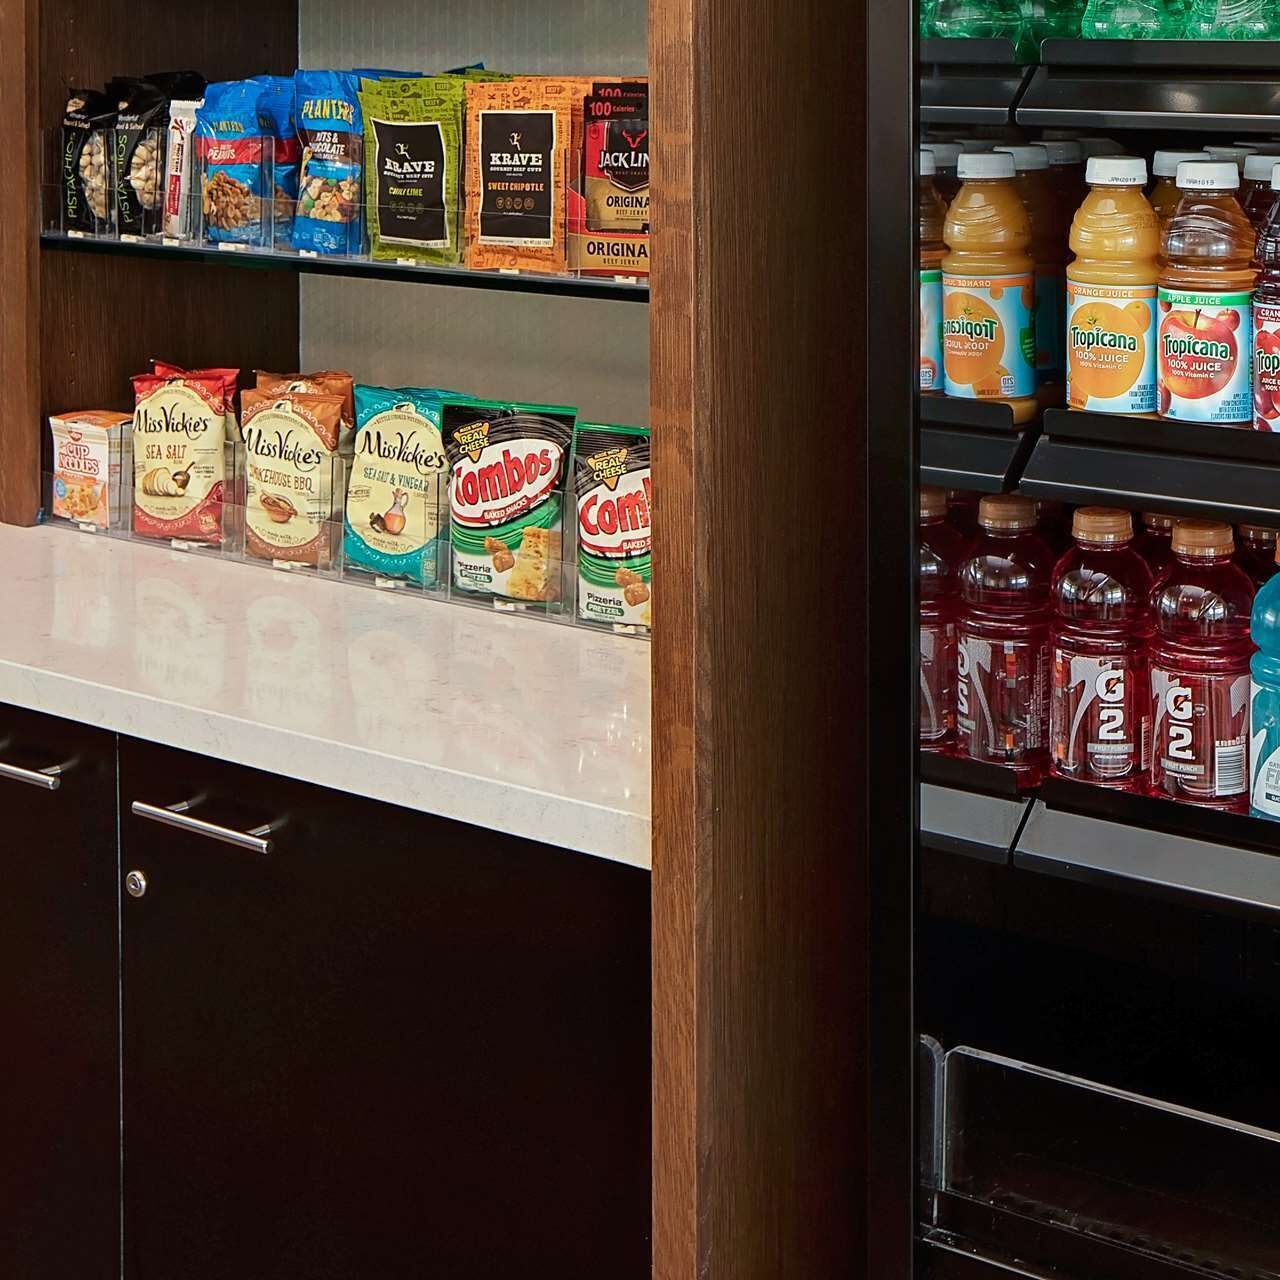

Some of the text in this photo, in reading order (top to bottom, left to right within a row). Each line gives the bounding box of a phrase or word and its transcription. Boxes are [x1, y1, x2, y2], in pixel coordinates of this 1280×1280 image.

[302, 99, 354, 125] PLANTERS
[589, 102, 612, 116] 100
[384, 159, 435, 173] KRAVE
[490, 153, 543, 166] KRAVE
[598, 151, 630, 168] JACK
[488, 181, 544, 192] SWEET CHIPOTLE
[1074, 287, 1134, 298] ORANGE JUICE
[1167, 294, 1220, 305] APPLE JUICE
[1071, 325, 1137, 351] Tropicana
[1163, 334, 1230, 361] Tropicana
[1075, 350, 1128, 363] 100% JUICE
[1167, 360, 1222, 371] 100% JUICE
[1262, 378, 1280, 386] JUICE
[460, 429, 483, 444] REAL
[65, 443, 90, 458] CUP
[146, 444, 187, 459] SEA SALT
[360, 430, 445, 475] Miss Vickie's
[458, 438, 490, 454] CHEESE
[58, 455, 100, 474] NOODLES
[596, 457, 622, 470] REAL
[455, 447, 553, 507] Combos
[593, 464, 627, 480] CHEESE
[294, 476, 314, 493] BBQ
[484, 509, 504, 520] BAKED
[622, 540, 646, 550] BAKED
[587, 592, 623, 607] Pizzeria
